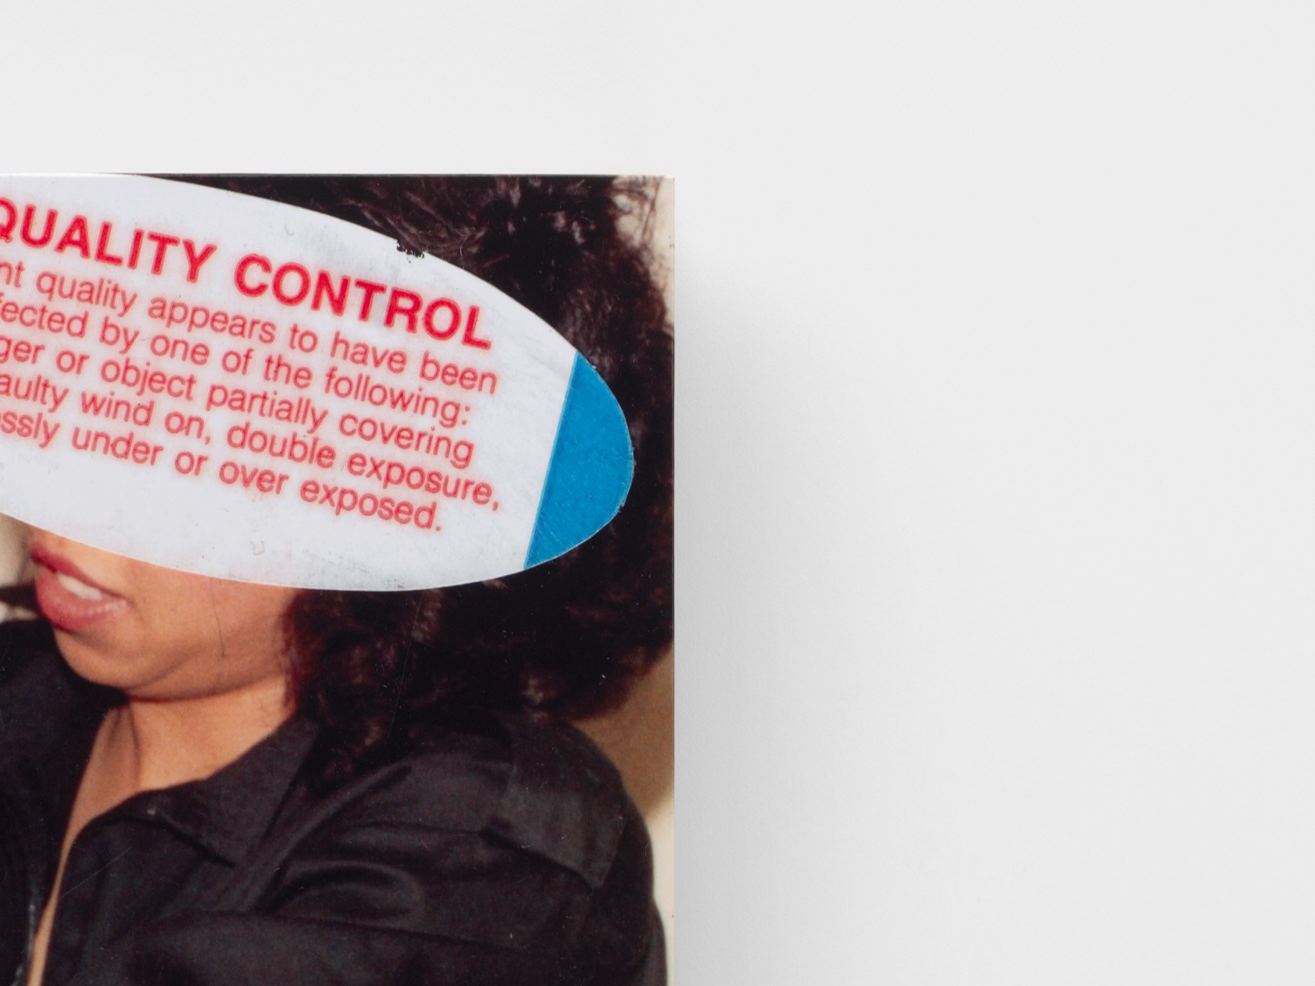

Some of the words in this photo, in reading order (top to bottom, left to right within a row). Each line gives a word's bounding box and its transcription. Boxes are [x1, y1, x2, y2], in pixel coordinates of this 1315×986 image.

[35, 271, 138, 318] quality
[147, 296, 276, 344] appears
[289, 324, 319, 353] to
[330, 331, 408, 374] have
[419, 352, 497, 394] been
[233, 253, 492, 351] CONTROL
[55, 350, 90, 375] or
[100, 357, 196, 401] object
[205, 383, 328, 434] partially
[338, 414, 474, 470] covering
[99, 316, 140, 355] by
[149, 334, 210, 365] one
[221, 347, 254, 375] of
[263, 354, 313, 390] the
[324, 366, 470, 429] following:
[72, 428, 163, 465] under
[174, 451, 208, 475] or
[218, 461, 289, 494] over
[300, 480, 443, 532] exposed.
[81, 392, 155, 427] wind
[164, 411, 212, 447] on,
[226, 421, 337, 469] double
[347, 452, 500, 512] exposure,
